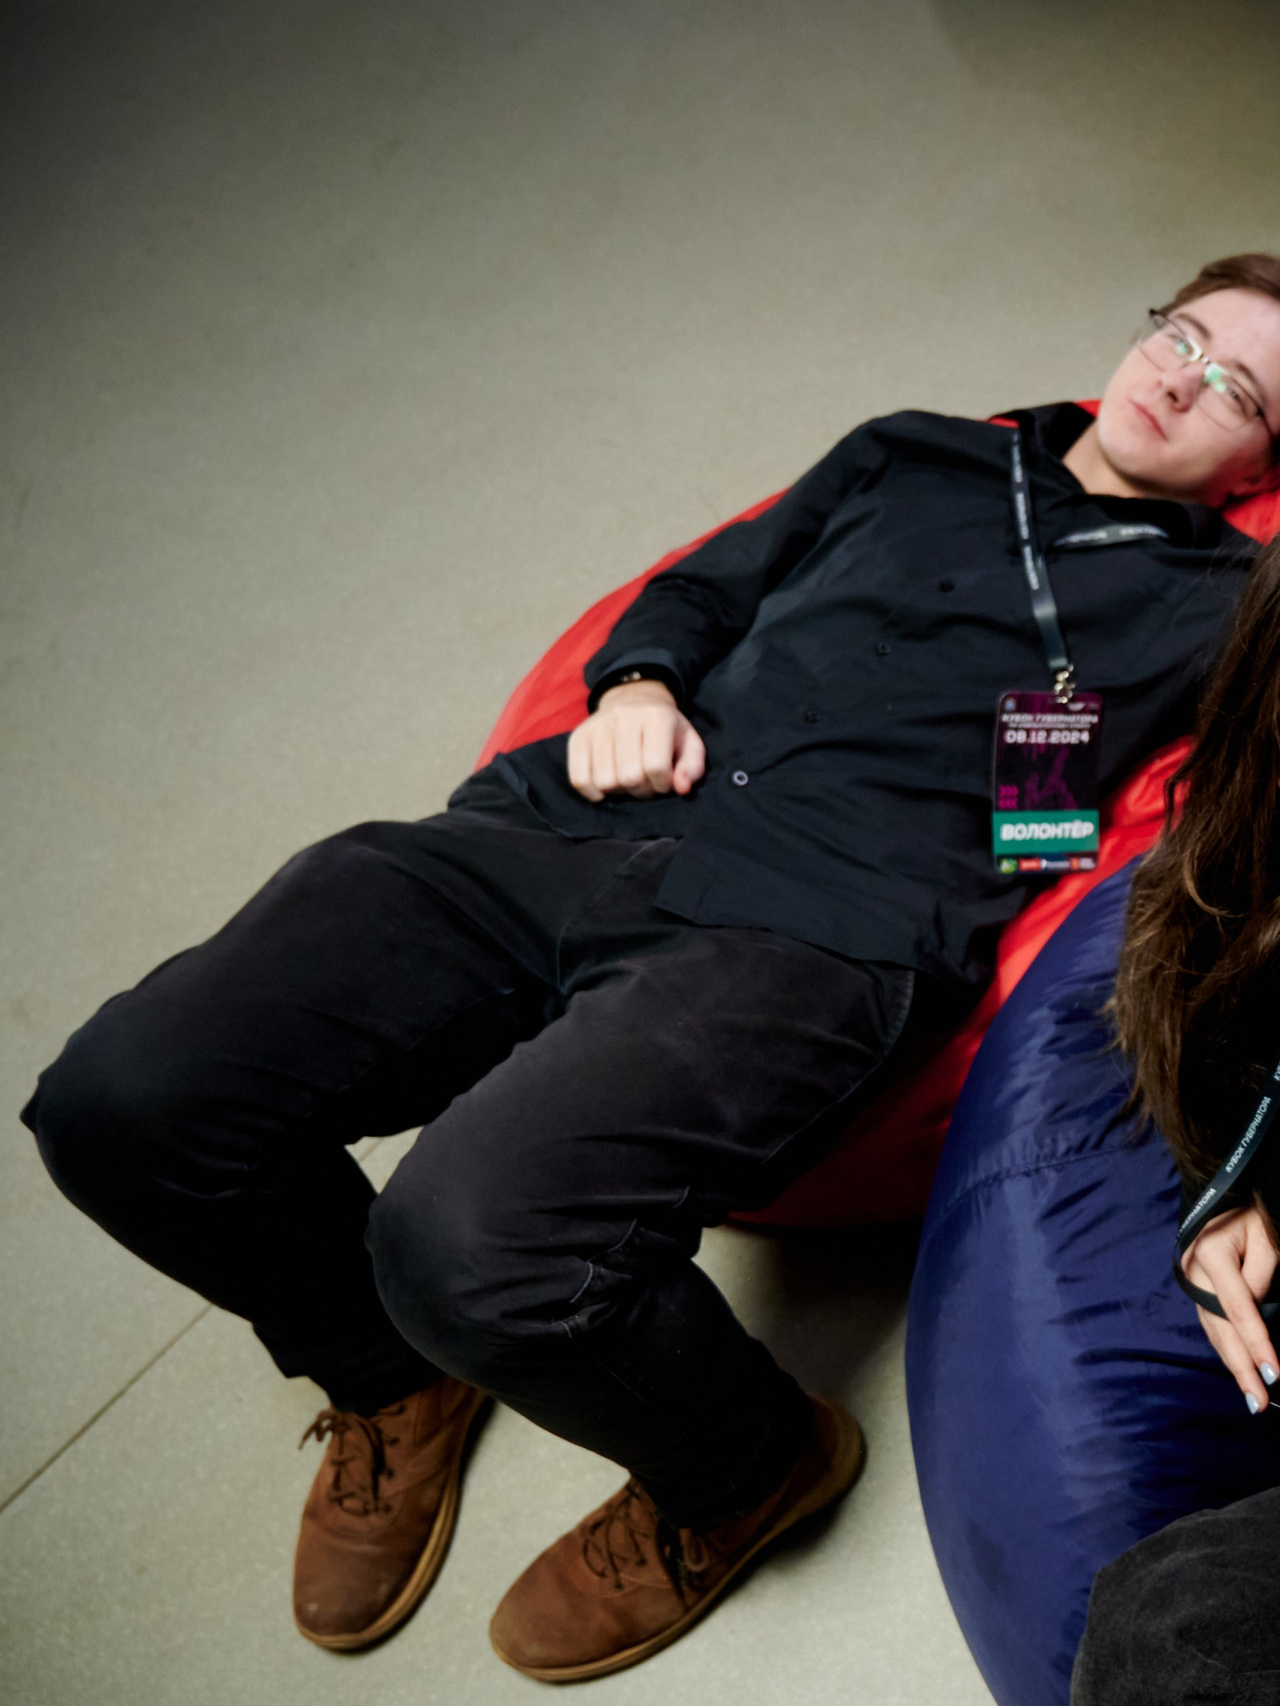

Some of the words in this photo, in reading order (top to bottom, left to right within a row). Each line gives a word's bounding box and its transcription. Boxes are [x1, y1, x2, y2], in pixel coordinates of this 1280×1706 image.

[1004, 729, 1091, 745] 08.12.2024
[1000, 818, 1095, 842] ВОЛОНТЁР
[1225, 1145, 1246, 1174] КУБОК
[1241, 1096, 1273, 1148] ГУБЕРНАТОРА
